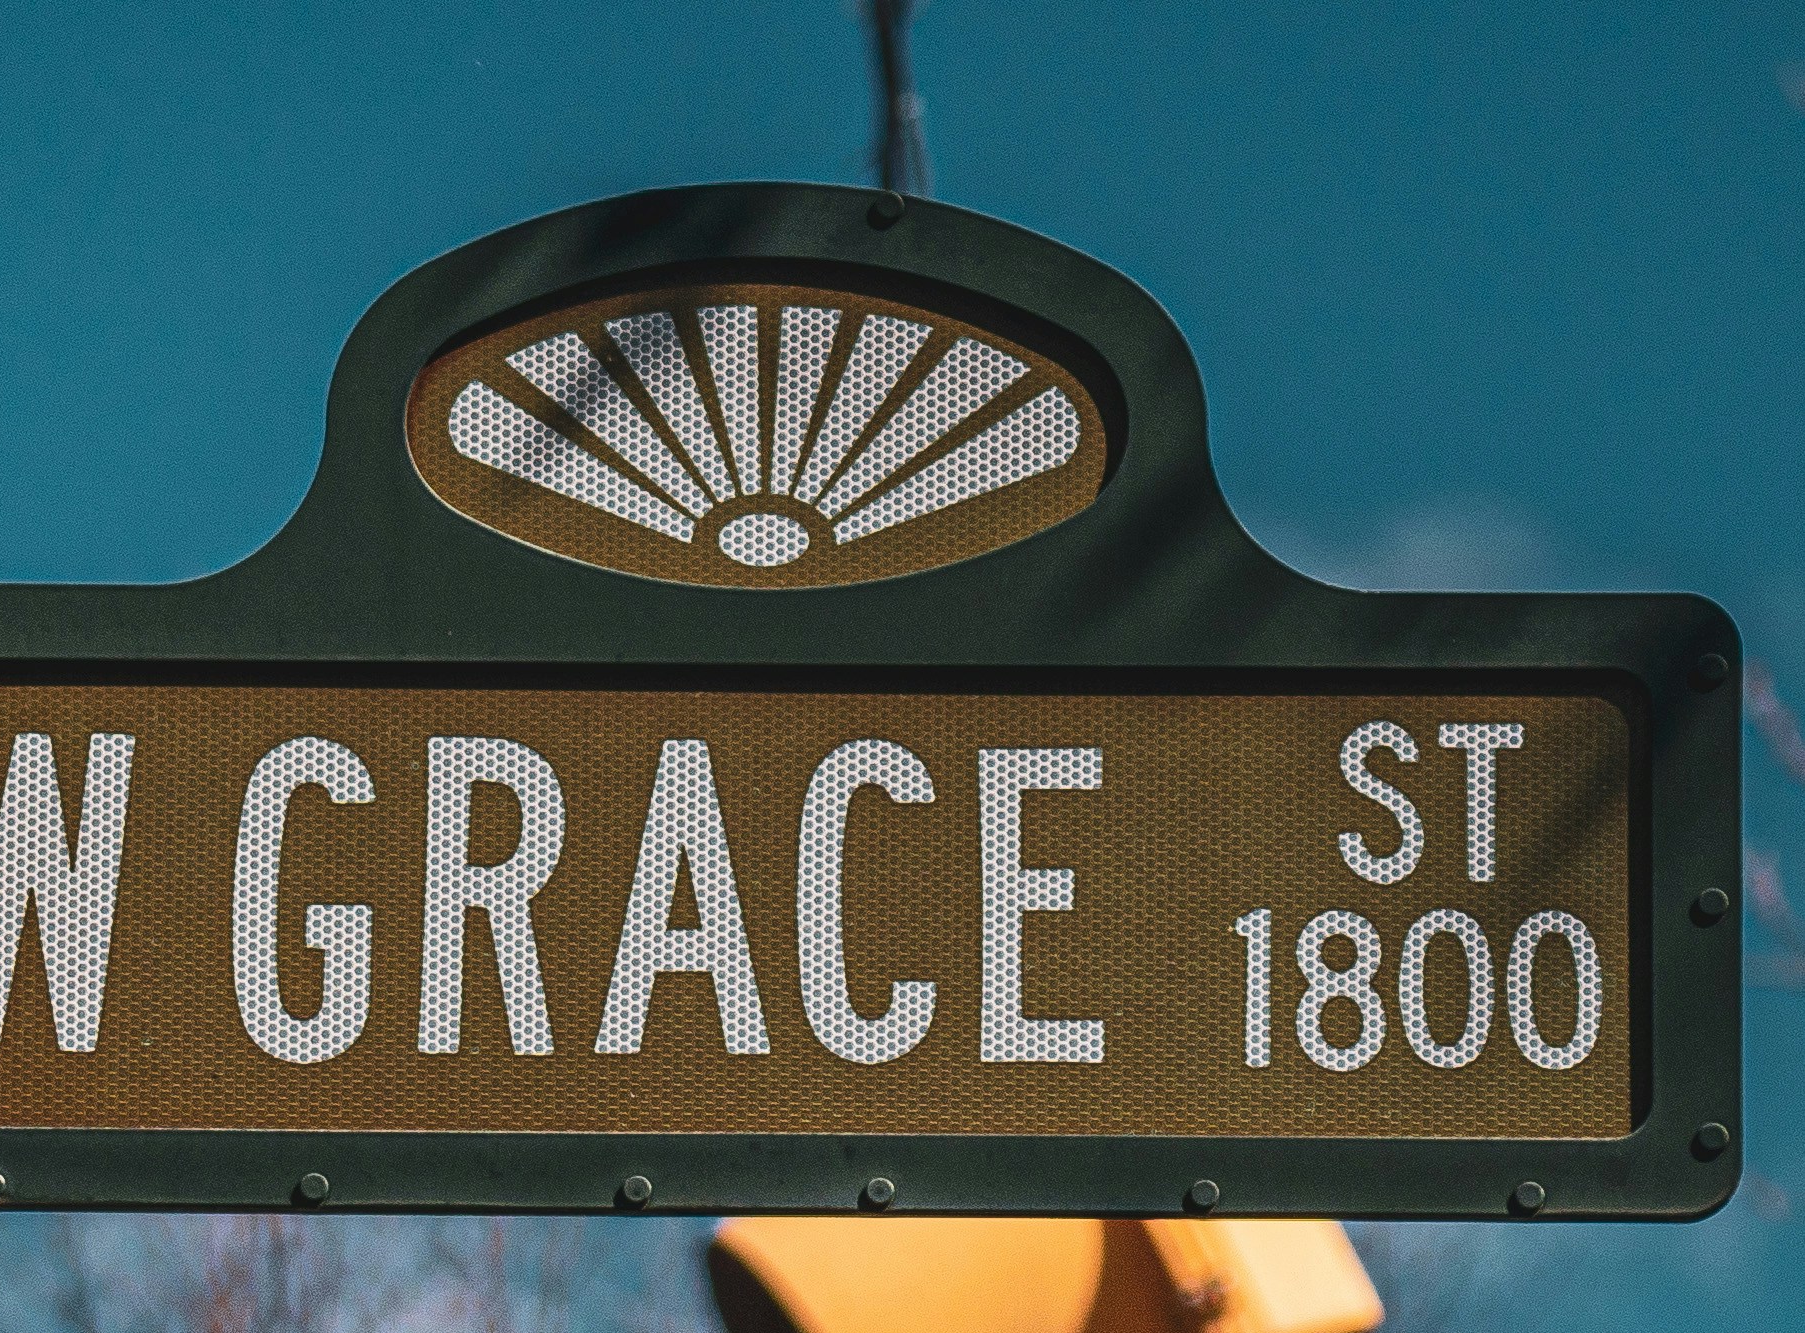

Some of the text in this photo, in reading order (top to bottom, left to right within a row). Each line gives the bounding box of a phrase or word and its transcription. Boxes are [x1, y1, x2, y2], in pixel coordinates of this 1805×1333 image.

[1336, 719, 1526, 886] ST
[231, 734, 1107, 1067] GRACE
[1232, 906, 1604, 1073] 1800
